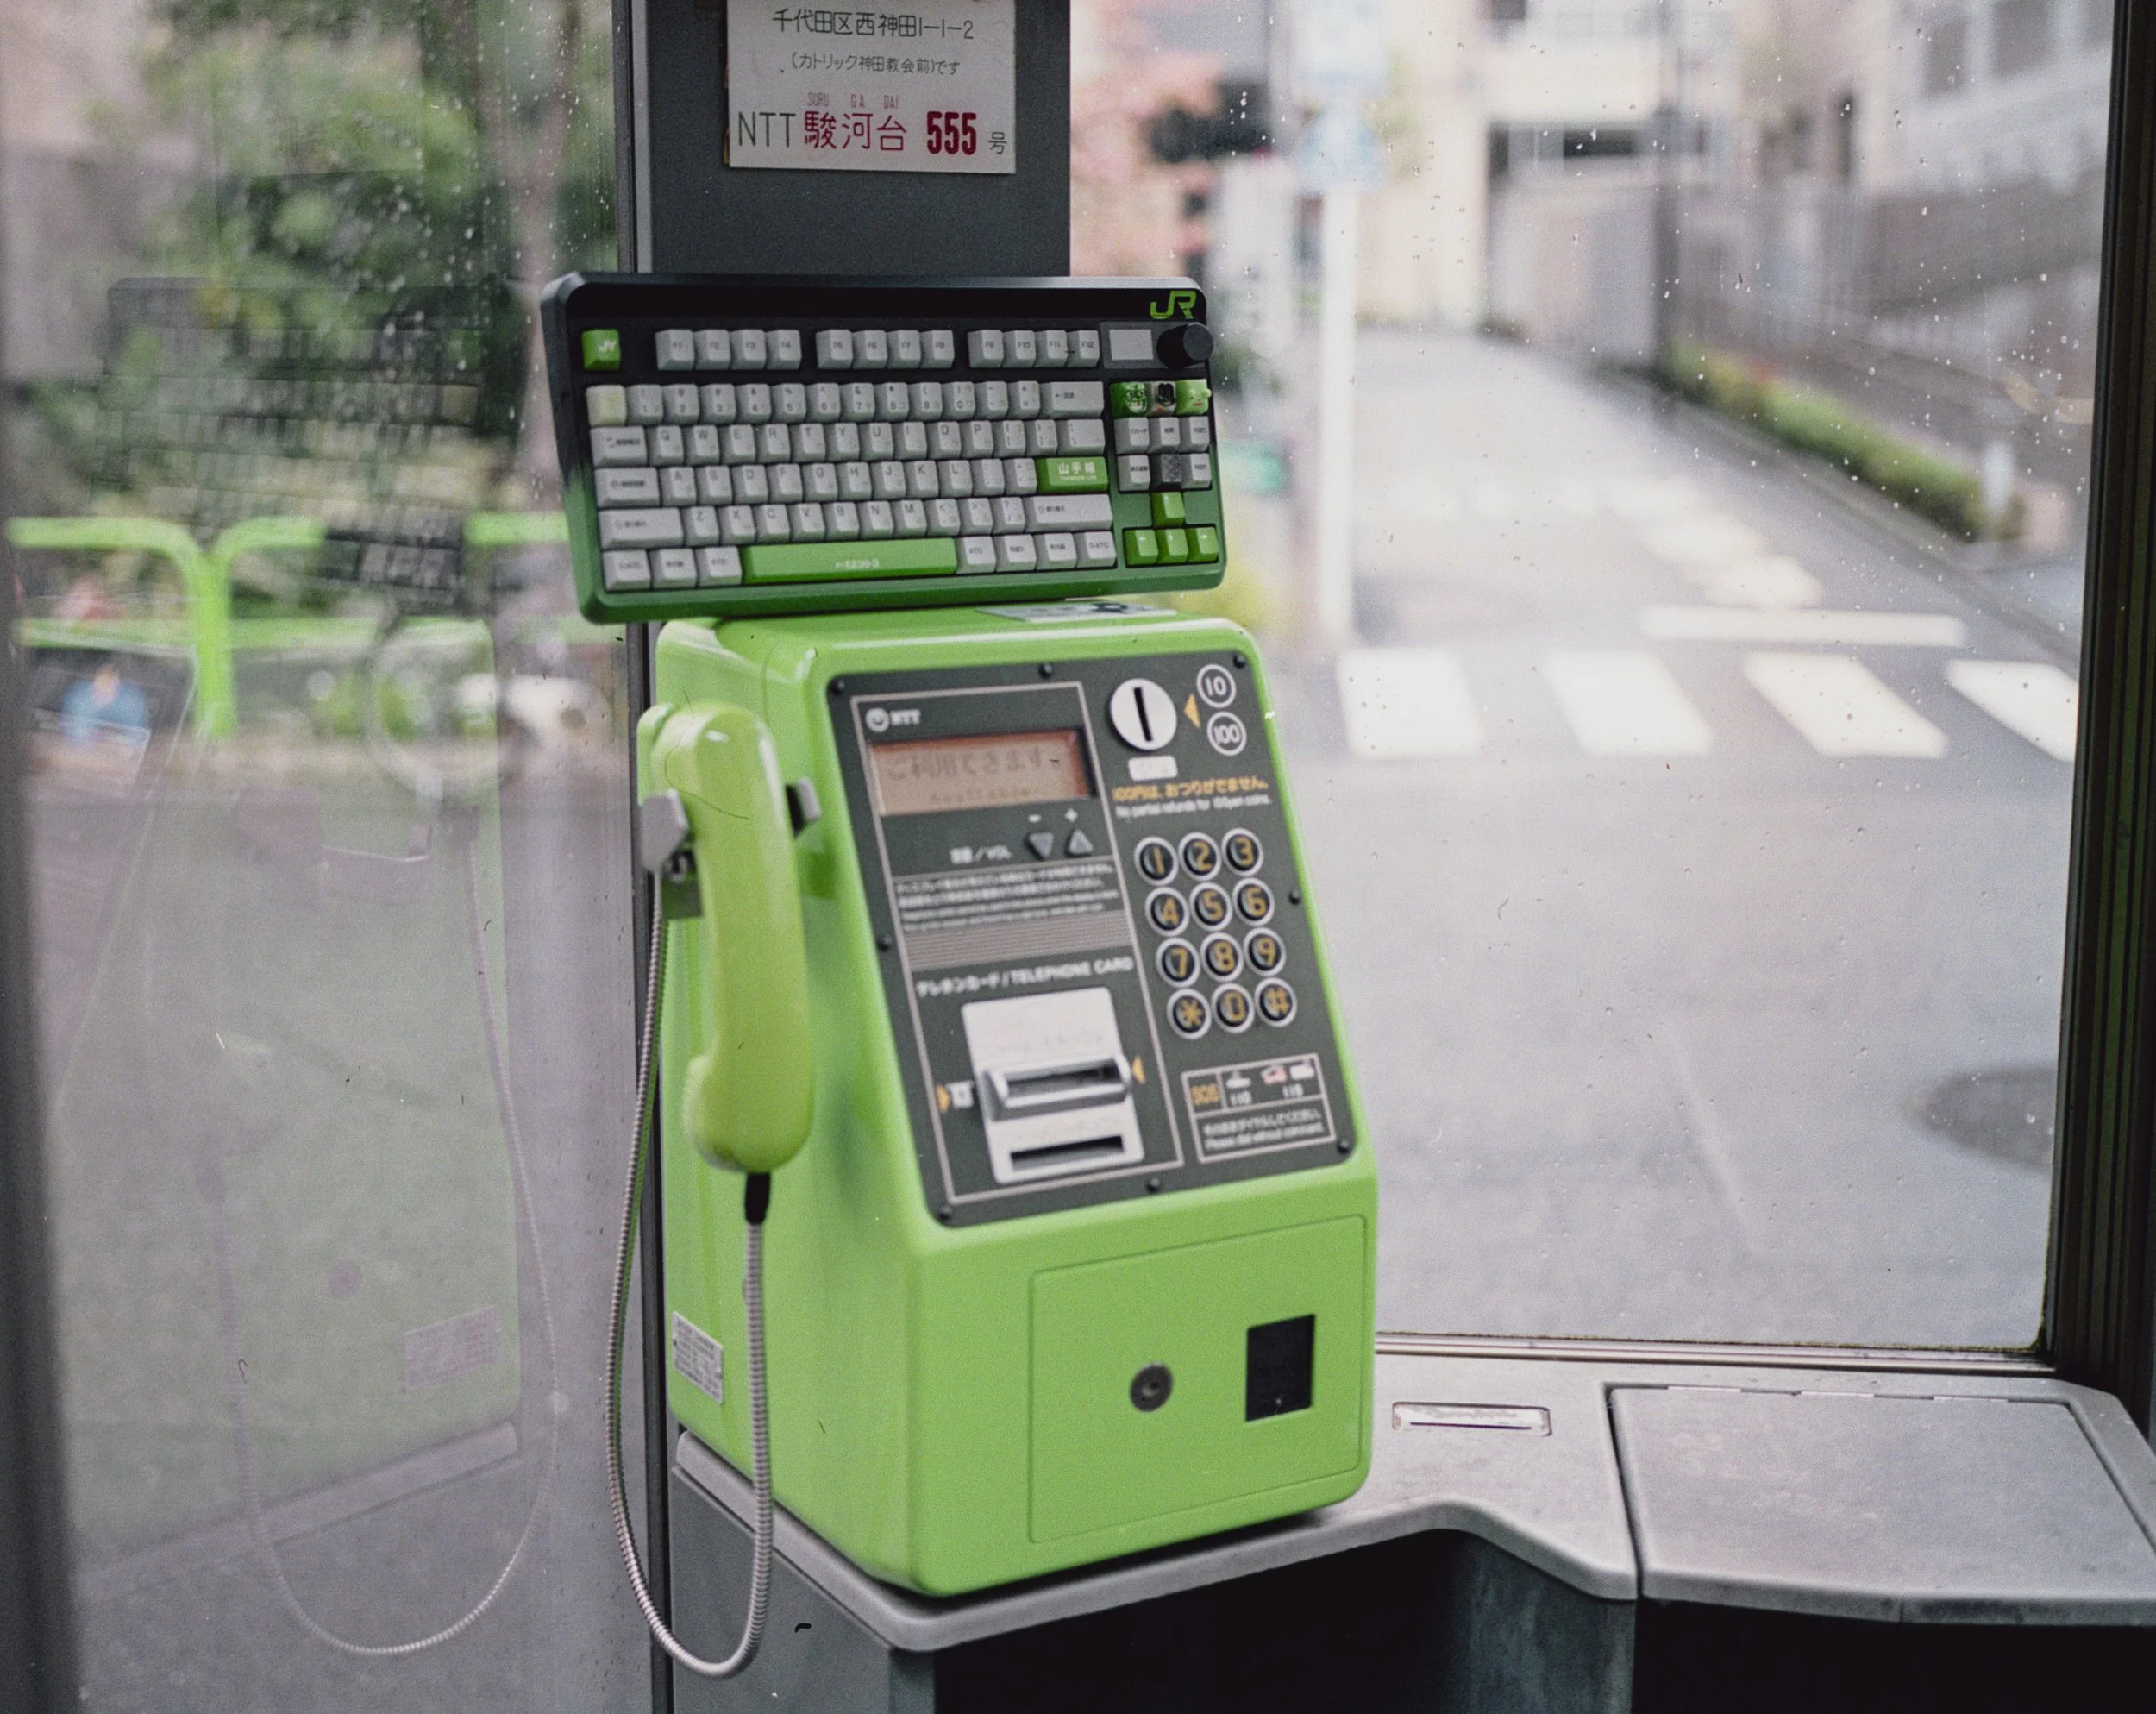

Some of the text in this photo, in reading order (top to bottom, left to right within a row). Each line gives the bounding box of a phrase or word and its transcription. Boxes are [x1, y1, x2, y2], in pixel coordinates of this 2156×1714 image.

[738, 110, 1008, 156] NTT 駿河台 555 号
[1150, 290, 1197, 319] JR
[1206, 676, 1226, 696] 10
[889, 708, 1240, 745] NTT 100
[1152, 836, 1254, 875] 1 2 3
[1163, 887, 1267, 926] 4 5 6
[1093, 956, 1135, 975] CARD
[1169, 936, 1276, 977] 7 8 9
[1223, 990, 1246, 1022] 0
